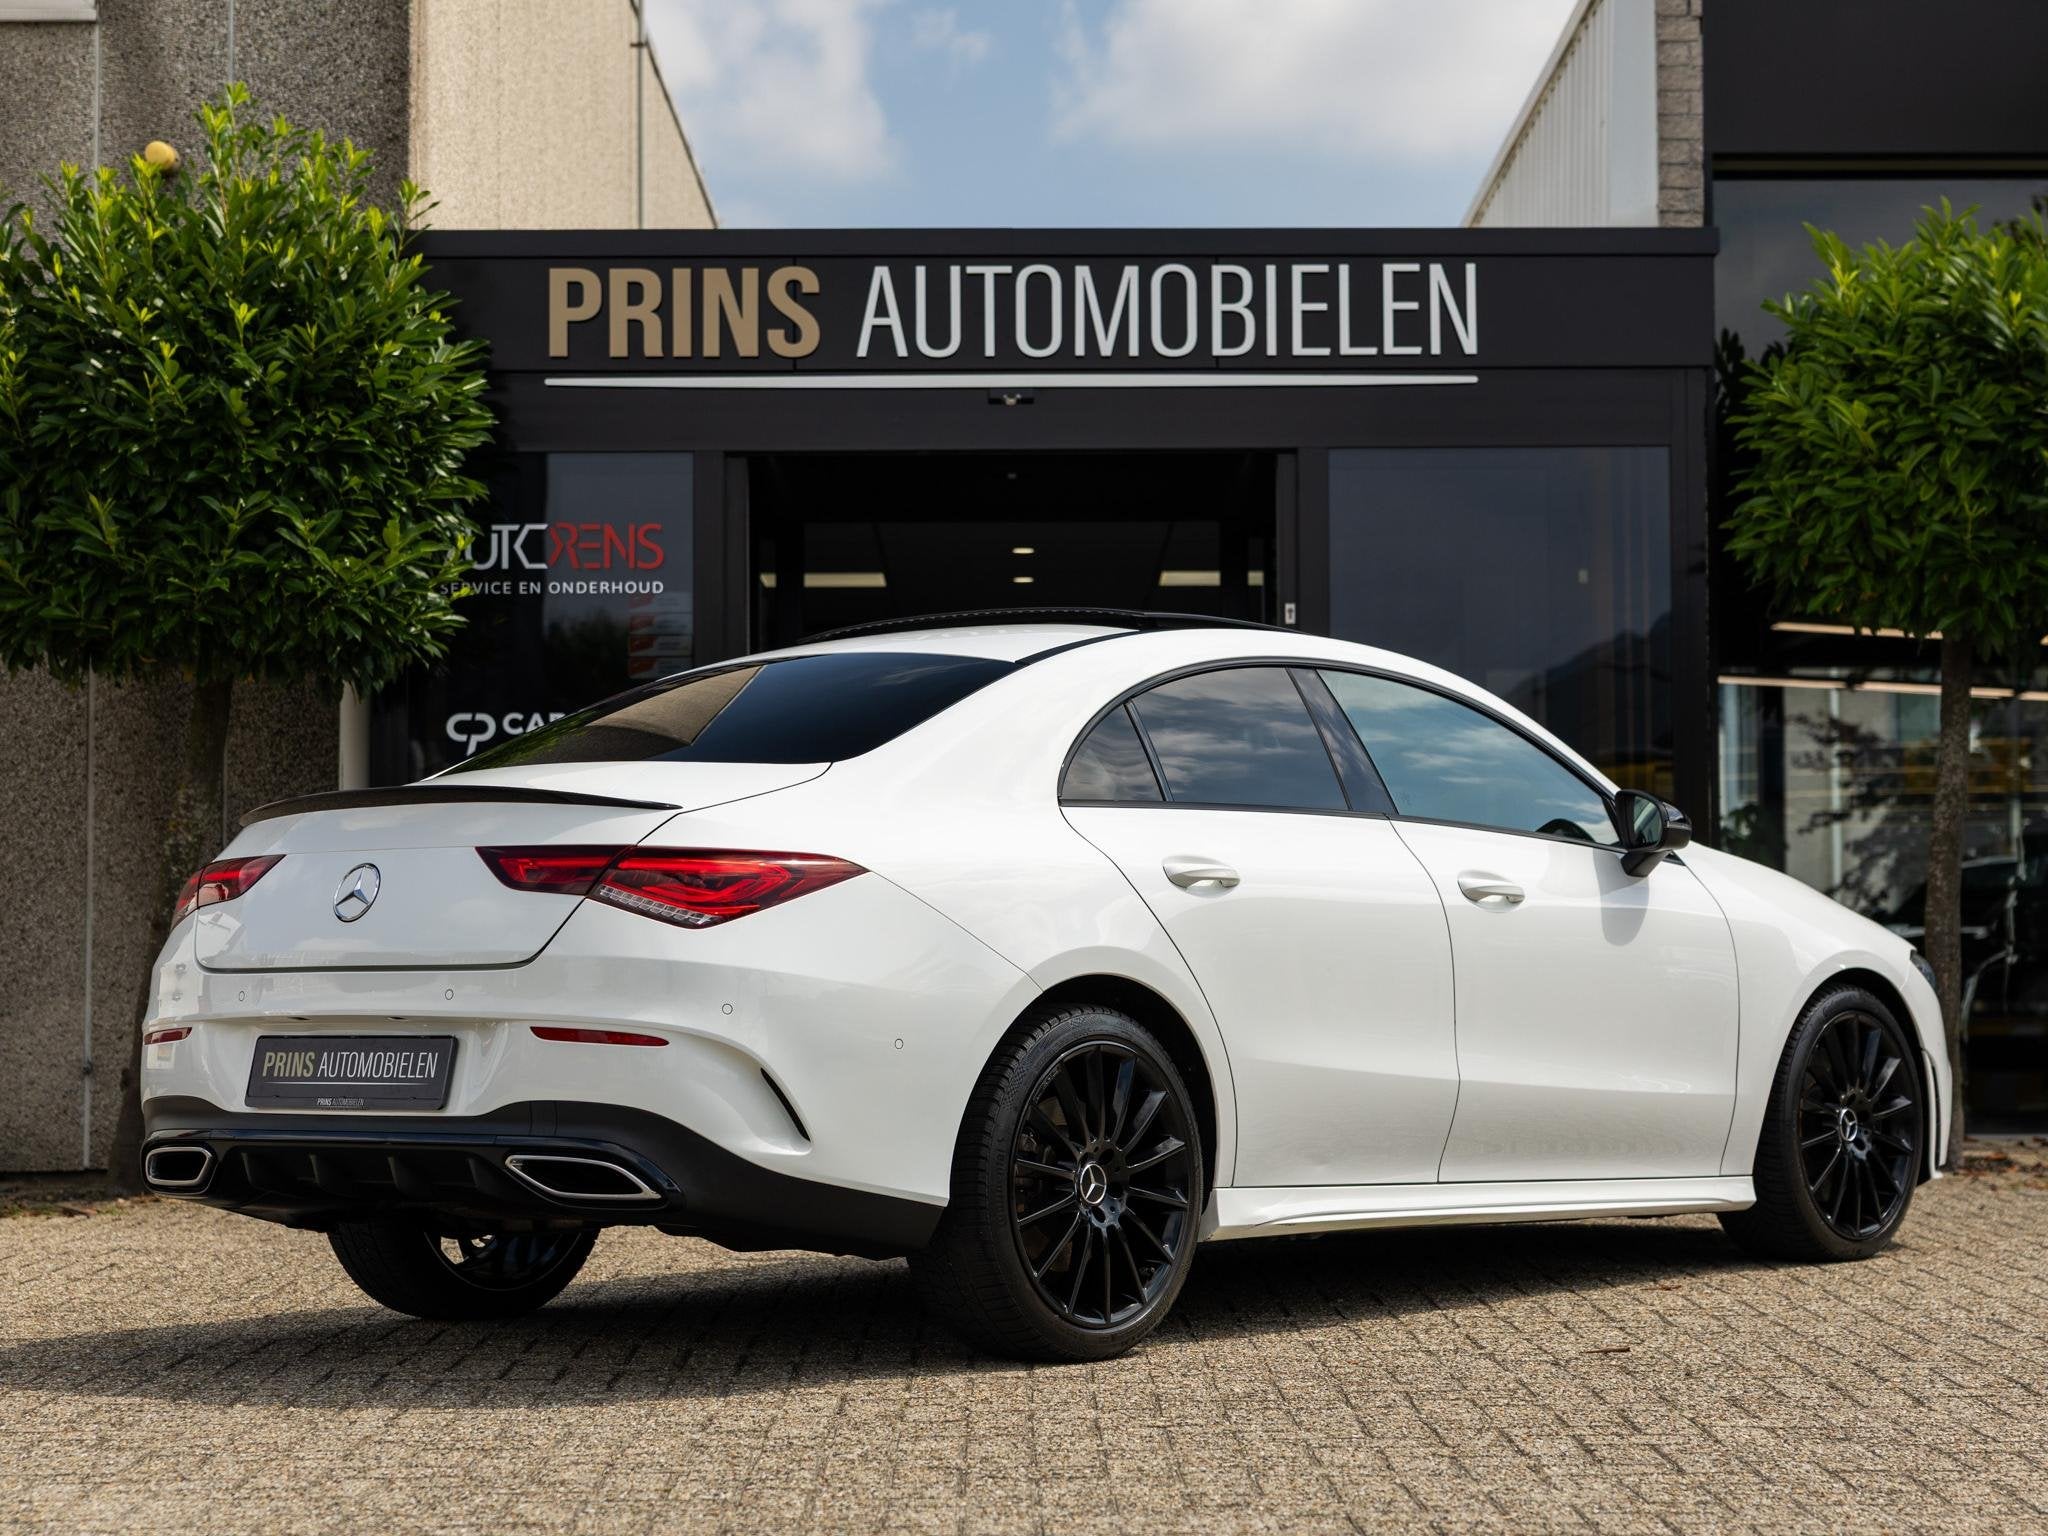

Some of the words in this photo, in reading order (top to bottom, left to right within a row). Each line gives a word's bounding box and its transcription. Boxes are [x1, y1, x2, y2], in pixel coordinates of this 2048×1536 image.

[549, 266, 820, 358] PRINS
[856, 263, 1478, 358] AUTOMOBIELEN
[519, 581, 541, 595] EN
[548, 581, 664, 595] ONDERHOUD
[263, 1052, 315, 1077] PRINS
[318, 1052, 438, 1078] AUTOMOBIELEN
[317, 1098, 332, 1106] PRINS
